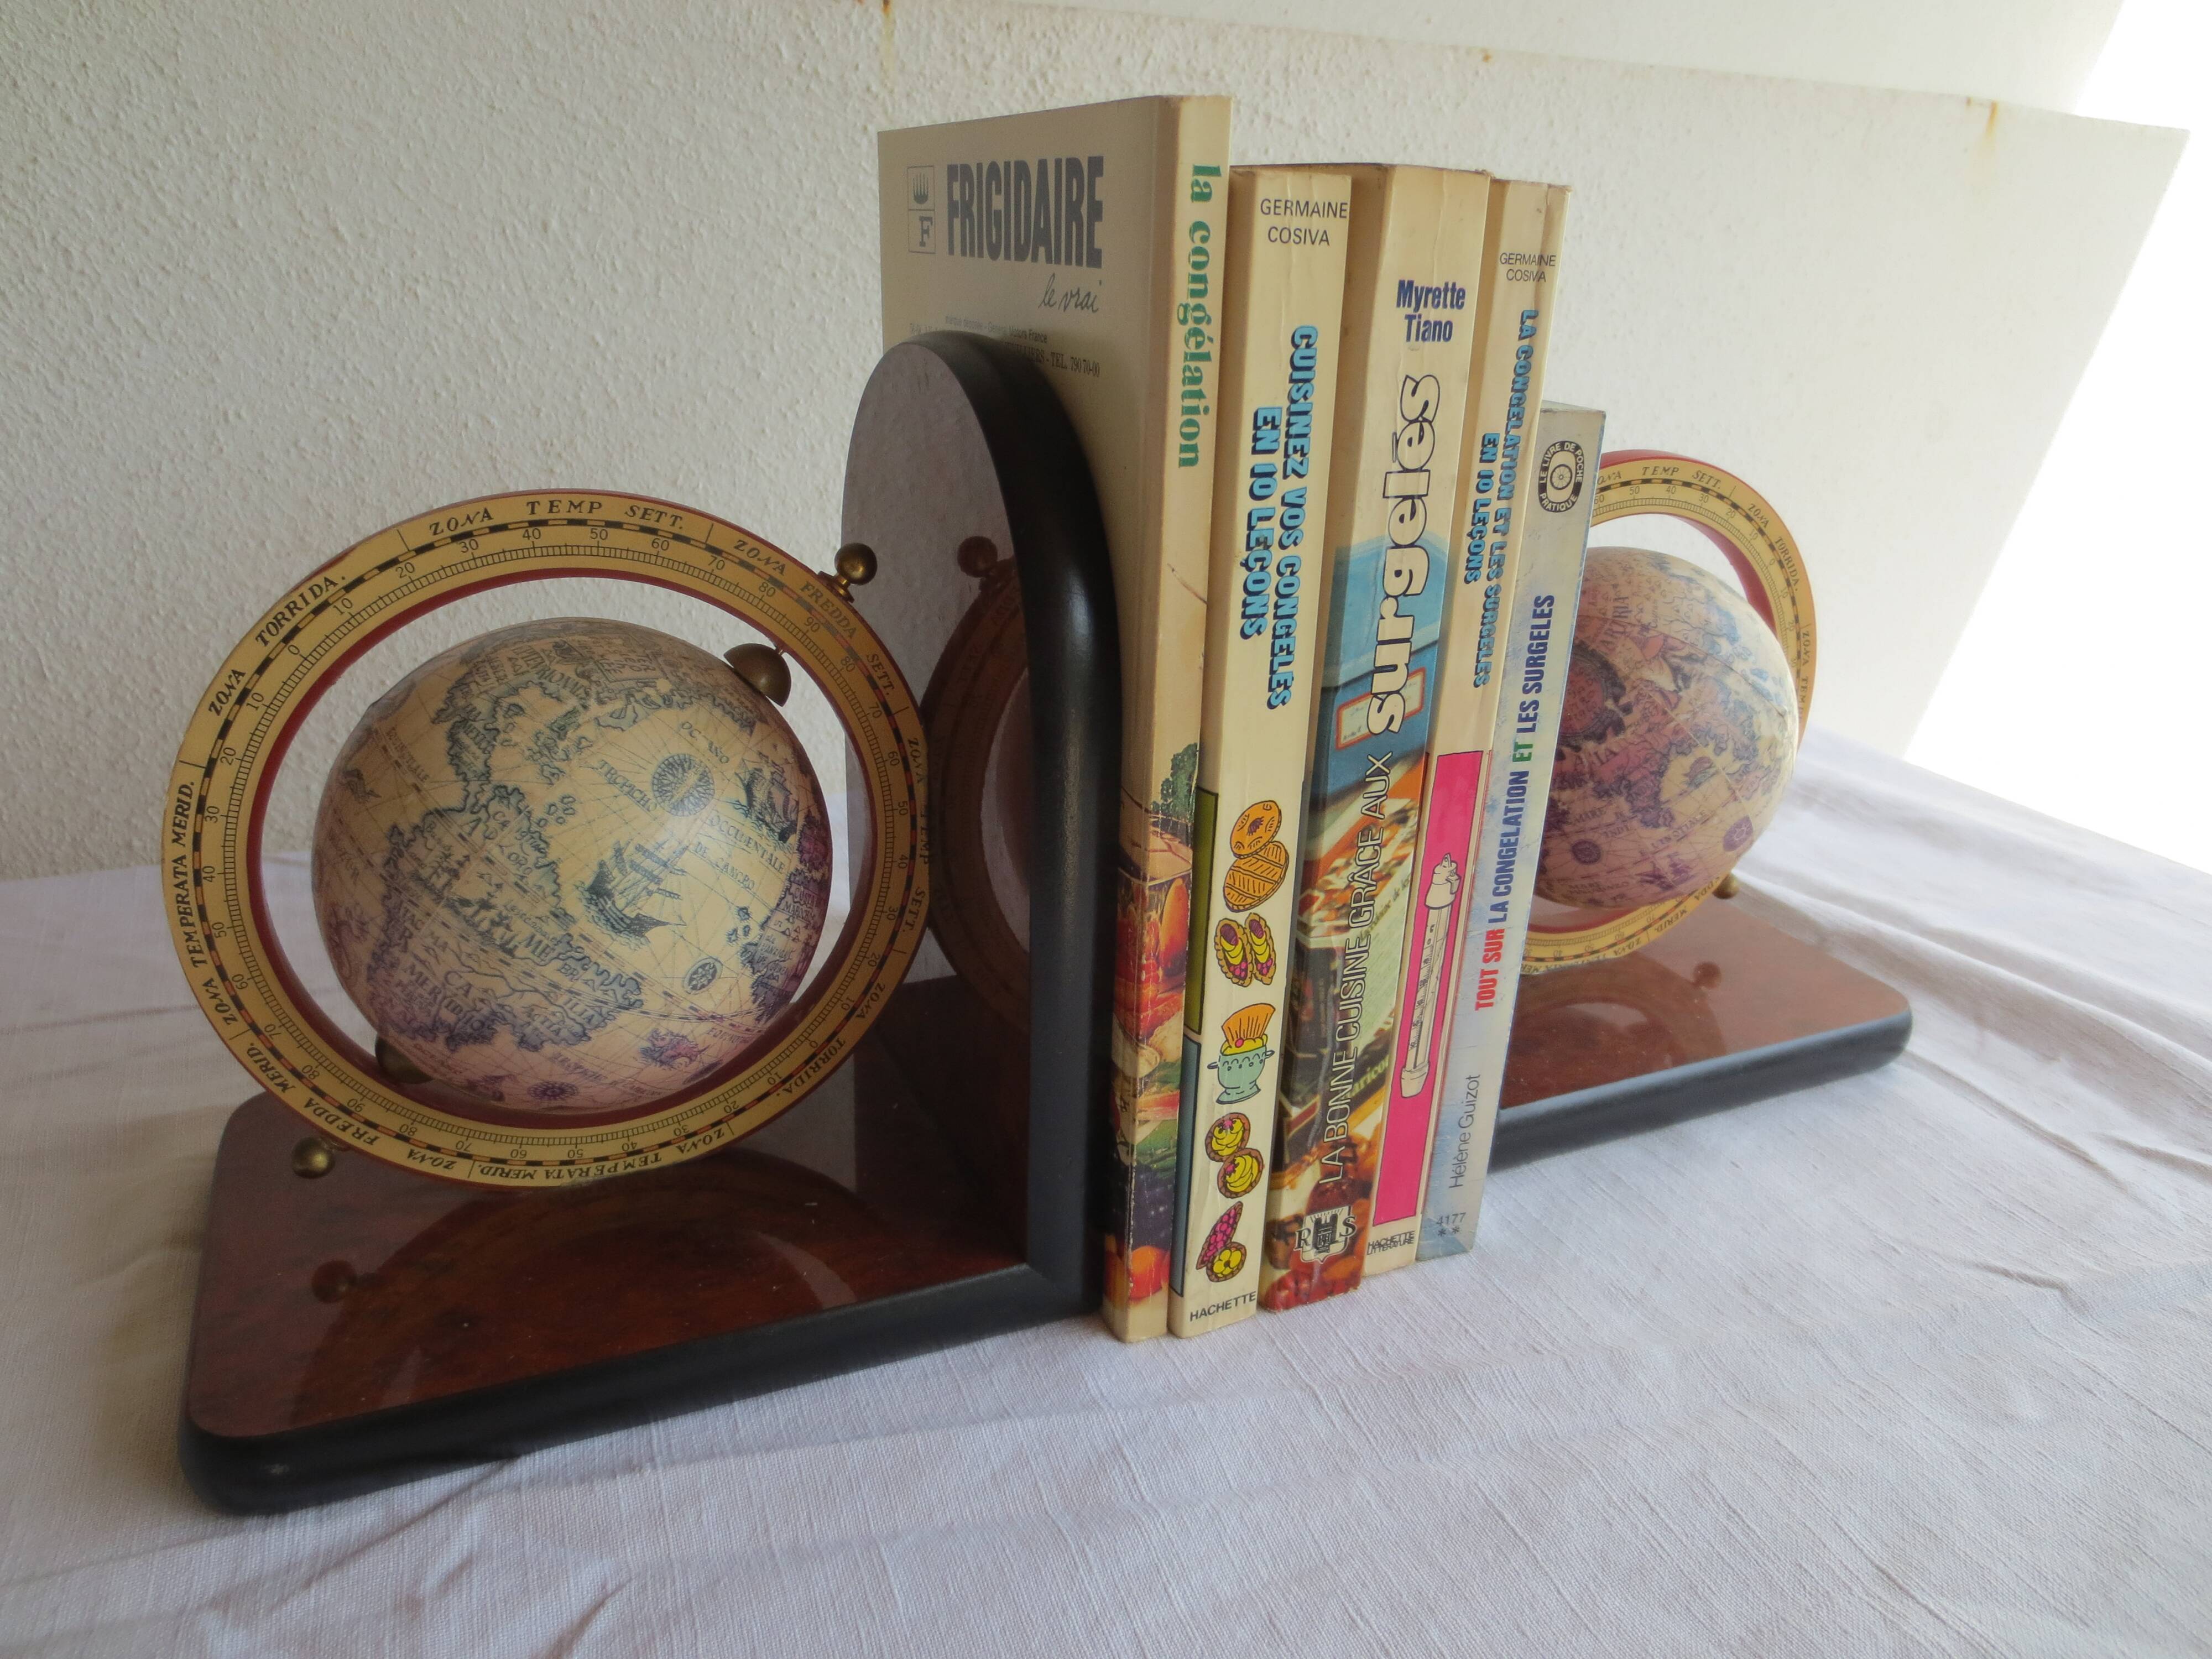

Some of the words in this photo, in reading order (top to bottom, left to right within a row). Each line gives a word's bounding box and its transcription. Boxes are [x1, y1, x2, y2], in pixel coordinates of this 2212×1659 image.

[1191, 164, 1222, 203] la
[946, 155, 1104, 269] FRIGIDAIRE
[1260, 197, 1349, 219] GERMAINE
[918, 215, 933, 247] F
[1267, 227, 1331, 247] COSIVA
[1499, 252, 1557, 268] GERMAINE
[1506, 269, 1547, 283] COSIVA
[1037, 272, 1057, 310] le
[1058, 279, 1102, 314] vrai
[1396, 279, 1467, 313] Myrette
[1404, 314, 1453, 343] Tiano
[1519, 309, 1540, 341] LA
[1177, 220, 1214, 468] congélation
[1283, 325, 1318, 479] CUISINEZ
[1251, 406, 1283, 455] EN
[1497, 343, 1533, 501] CONGELATION
[1478, 432, 1500, 466] EN
[1542, 443, 1561, 467] LIVRE
[1563, 442, 1577, 452] DE
[1539, 471, 1548, 483] LE
[1574, 448, 1584, 483] POCHE
[1597, 471, 1623, 485] ONA
[1641, 466, 1680, 476] TEMP
[1691, 469, 1722, 489] SETT.
[1249, 463, 1278, 501] 10
[1539, 493, 1578, 512] PRATIQUE
[429, 507, 494, 536] ZONA
[526, 500, 603, 515] TEMP
[624, 503, 685, 530] SETT.
[1278, 486, 1307, 550] VOS
[1491, 507, 1512, 538] ET
[458, 538, 479, 553] 30
[522, 528, 542, 541] 40
[589, 526, 609, 541] 50
[650, 538, 670, 552] 60
[1463, 498, 1491, 585] LEÇONS
[1367, 374, 1441, 735] surgelés
[1747, 503, 1770, 529] ZONA
[1775, 536, 1801, 592] TORRIDA.
[395, 561, 416, 580] 20
[707, 555, 727, 571] 70
[1486, 539, 1508, 581] LES
[1239, 507, 1276, 640] LEÇONS
[758, 581, 776, 598] 80
[332, 596, 354, 617] 10
[733, 539, 787, 577] ZONA
[800, 581, 858, 640] FREDDA
[865, 653, 895, 696] SETT.
[804, 616, 821, 634] 90
[1473, 583, 1503, 688] SURGELES
[208, 667, 246, 717] ZONA
[255, 573, 346, 648] TORRIDA.
[288, 644, 301, 656] 0
[1521, 595, 1556, 694] SURGELES
[840, 655, 855, 673] 80
[245, 691, 265, 712] 10
[869, 703, 883, 719] 70
[1516, 700, 1539, 733] LES
[221, 748, 237, 766] 20
[888, 750, 901, 767] 60
[1512, 742, 1534, 763] ET
[1360, 752, 1393, 820] AUX
[171, 780, 196, 849] MERID.
[204, 805, 221, 824] 30
[897, 800, 909, 816] 50
[1492, 770, 1530, 898] CONGELATION
[898, 853, 908, 869] 40
[202, 865, 216, 883] 40
[1348, 827, 1386, 929] GRÂCE
[171, 854, 208, 969] TEMPERATA
[886, 905, 899, 921] 30
[901, 886, 926, 933] SETT.
[1488, 899, 1509, 924] LA
[213, 921, 227, 939] 50
[1483, 928, 1505, 964] SUR
[866, 952, 881, 968] 20
[231, 973, 249, 991] 60
[1335, 934, 1371, 1042] CUISINE
[1475, 968, 1503, 1011] TOUT
[202, 977, 239, 1025] ZONA
[841, 996, 855, 1011] 10
[856, 982, 886, 1020] ZONA
[264, 1023, 282, 1041] 70
[809, 1040, 818, 1049] 0
[246, 1042, 296, 1094] MERID.
[301, 1064, 321, 1081] 80
[766, 1072, 782, 1086] 10
[776, 1037, 846, 1097] TORRIDA.
[346, 1097, 366, 1113] 90
[723, 1099, 740, 1114] 20
[1323, 1046, 1358, 1143] BONNE
[1458, 1074, 1481, 1128] Guizot
[303, 1097, 381, 1146] FREDDA
[399, 1123, 419, 1137] 80
[672, 1124, 691, 1137] 30
[455, 1140, 473, 1151] 70
[620, 1141, 638, 1152] 40
[675, 1127, 726, 1155] ZONA
[406, 1148, 458, 1170] ZONA
[510, 1149, 528, 1159] 60
[544, 1152, 662, 1180] TEMPERATA
[567, 1149, 584, 1159] 50
[1319, 1145, 1349, 1185] LA
[1449, 1131, 1472, 1188] Hélène
[477, 1164, 538, 1180] MERID.
[1436, 1211, 1467, 1226] 4177
[1190, 1291, 1257, 1322] HACHETTE
